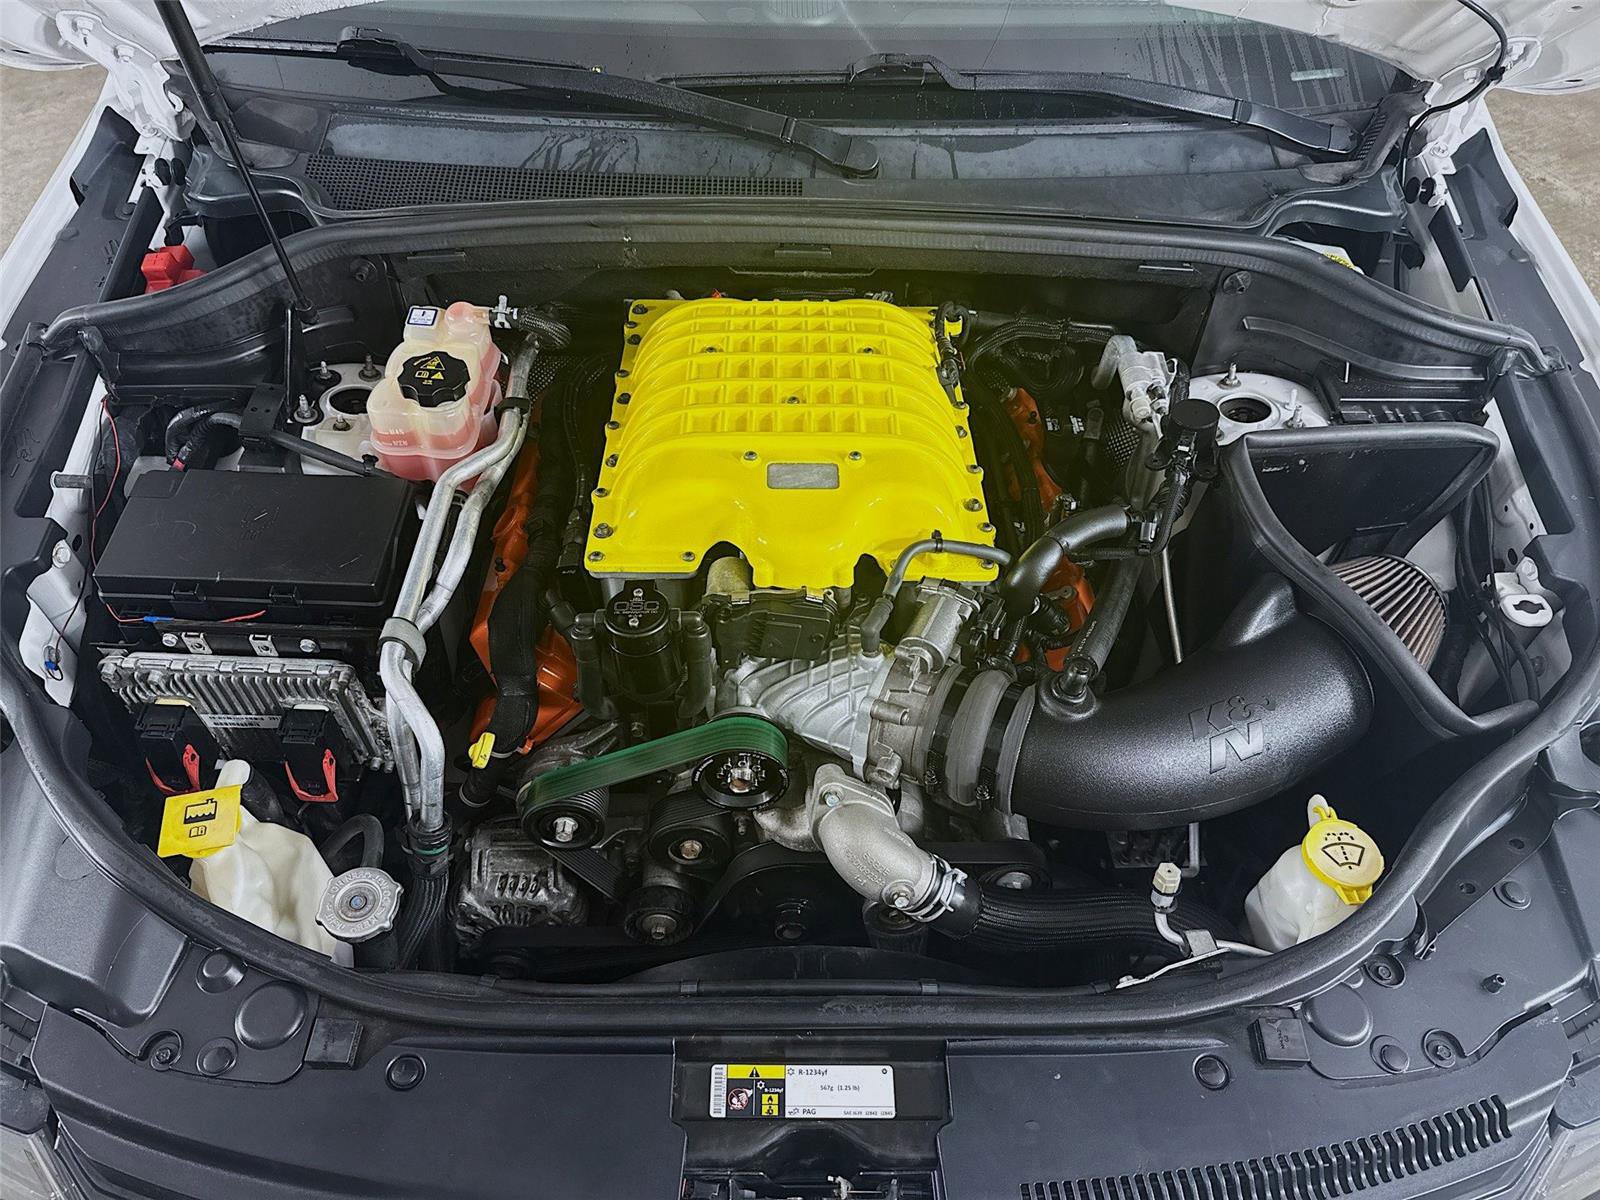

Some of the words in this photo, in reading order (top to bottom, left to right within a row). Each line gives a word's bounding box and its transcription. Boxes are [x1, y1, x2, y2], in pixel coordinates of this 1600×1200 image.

[798, 1068, 828, 1077] R-1234yf
[837, 1084, 851, 1092] (1.25
[852, 1084, 860, 1092] lb)
